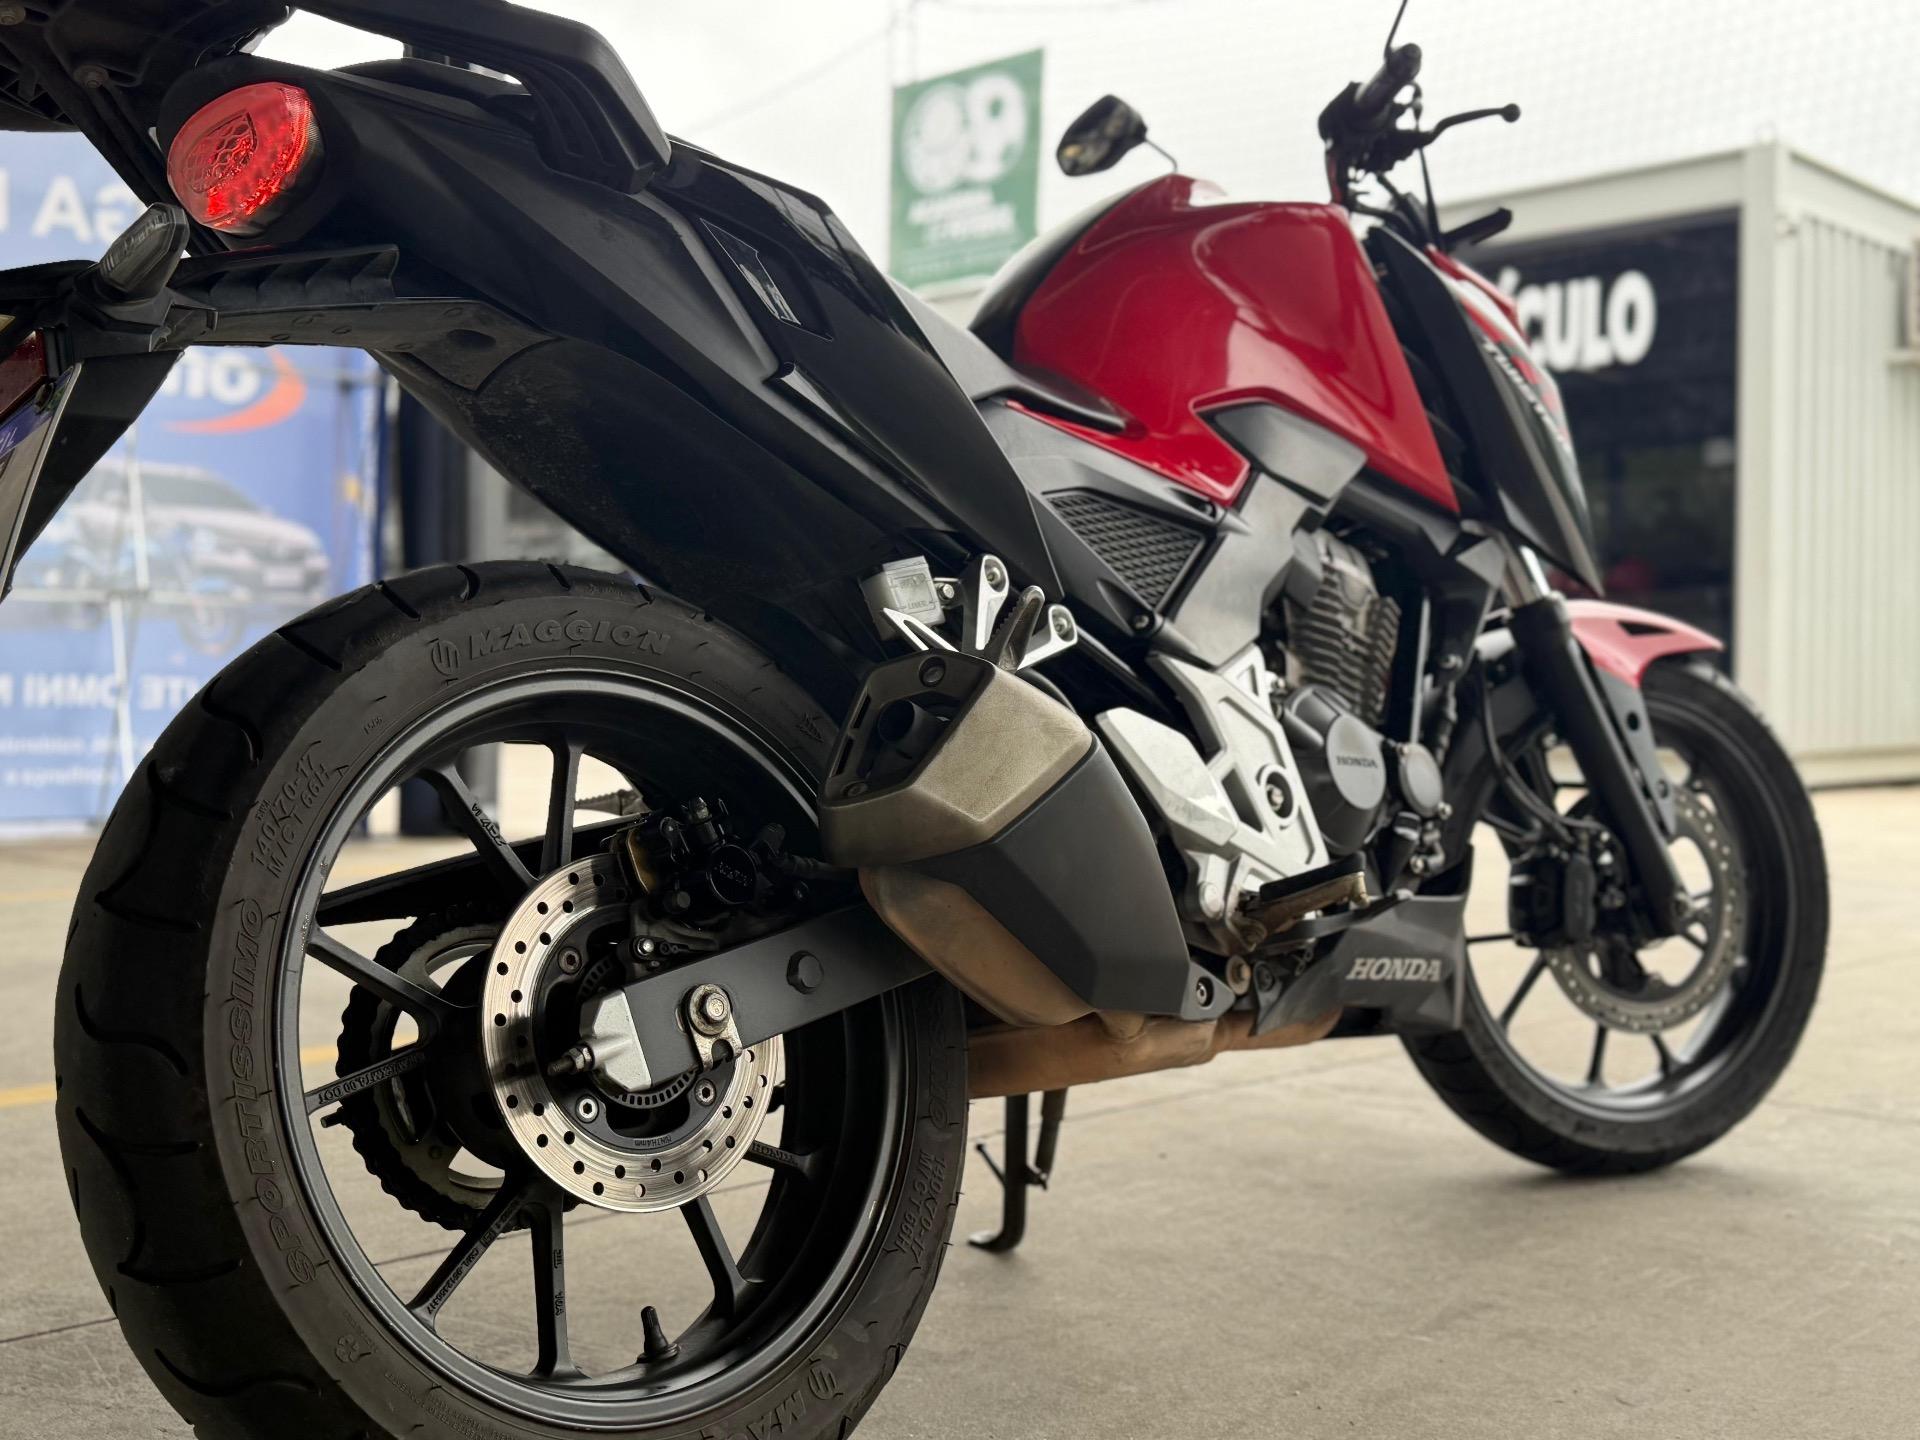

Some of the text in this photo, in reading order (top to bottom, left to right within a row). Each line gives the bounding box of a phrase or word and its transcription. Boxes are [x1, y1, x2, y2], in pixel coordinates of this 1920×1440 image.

[467, 619, 671, 656] MAGGION
[1335, 754, 1378, 769] HONDA
[1346, 957, 1443, 982] HONDA
[229, 897, 317, 1286] SPORTISSIMO
